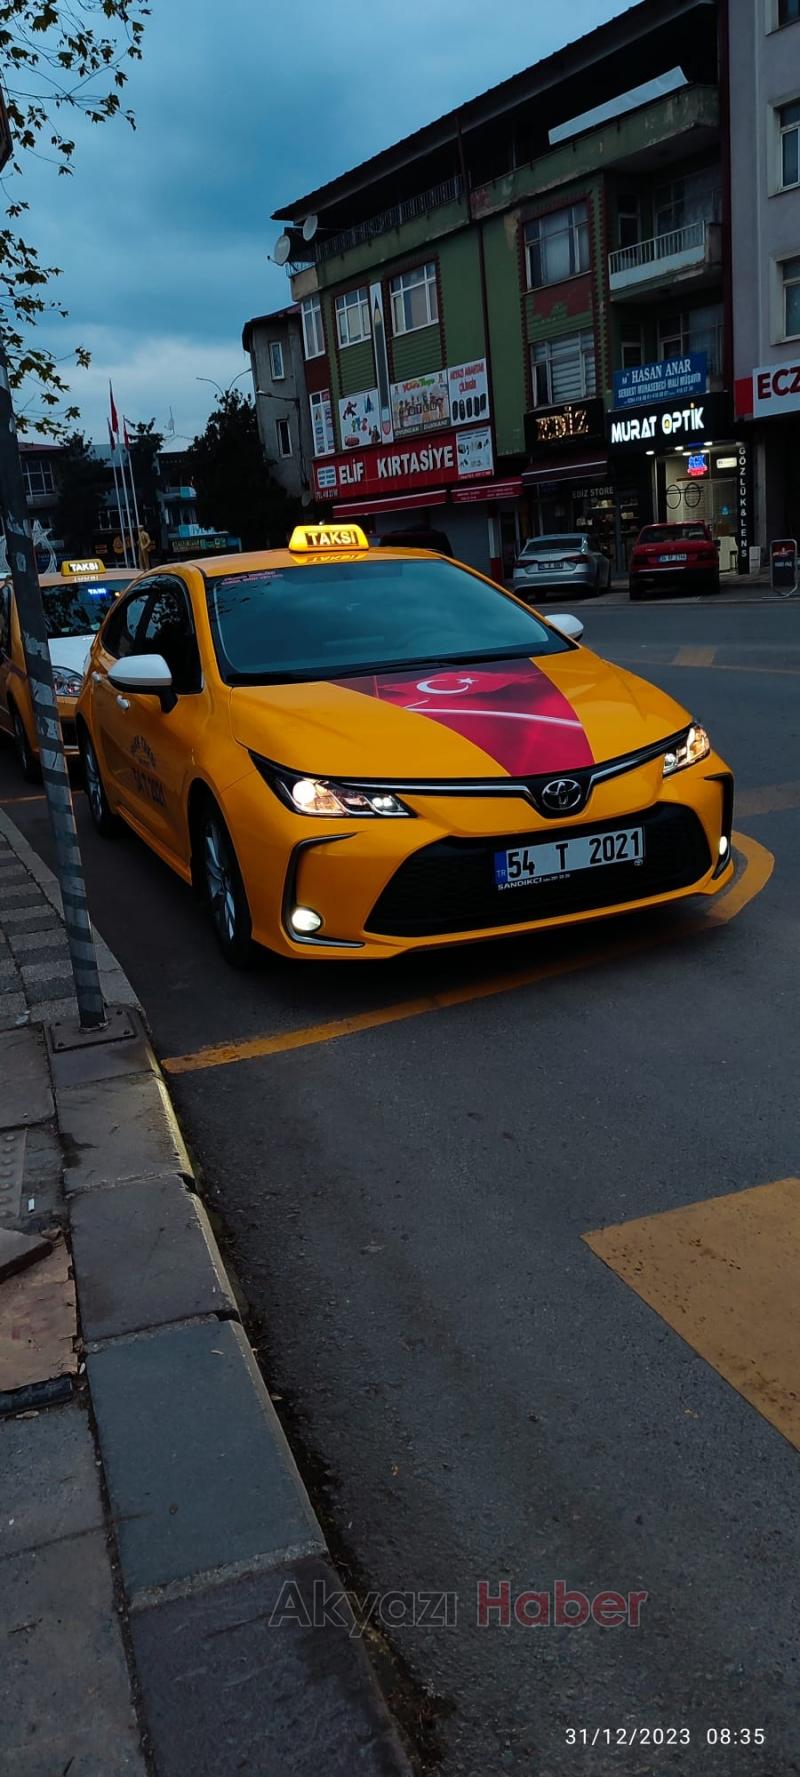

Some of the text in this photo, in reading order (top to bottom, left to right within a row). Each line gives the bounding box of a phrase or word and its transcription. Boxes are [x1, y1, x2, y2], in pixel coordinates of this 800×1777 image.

[631, 364, 662, 384] HASAN
[665, 358, 692, 377] ANAR
[758, 366, 800, 399] ECZ
[535, 405, 589, 442] EDİZ
[610, 402, 705, 444] MURAT OPTİK
[338, 457, 364, 486] ELİF
[378, 443, 454, 479] KIRTASİYE
[590, 486, 614, 497] STORE
[508, 831, 640, 878] 54 T 2021
